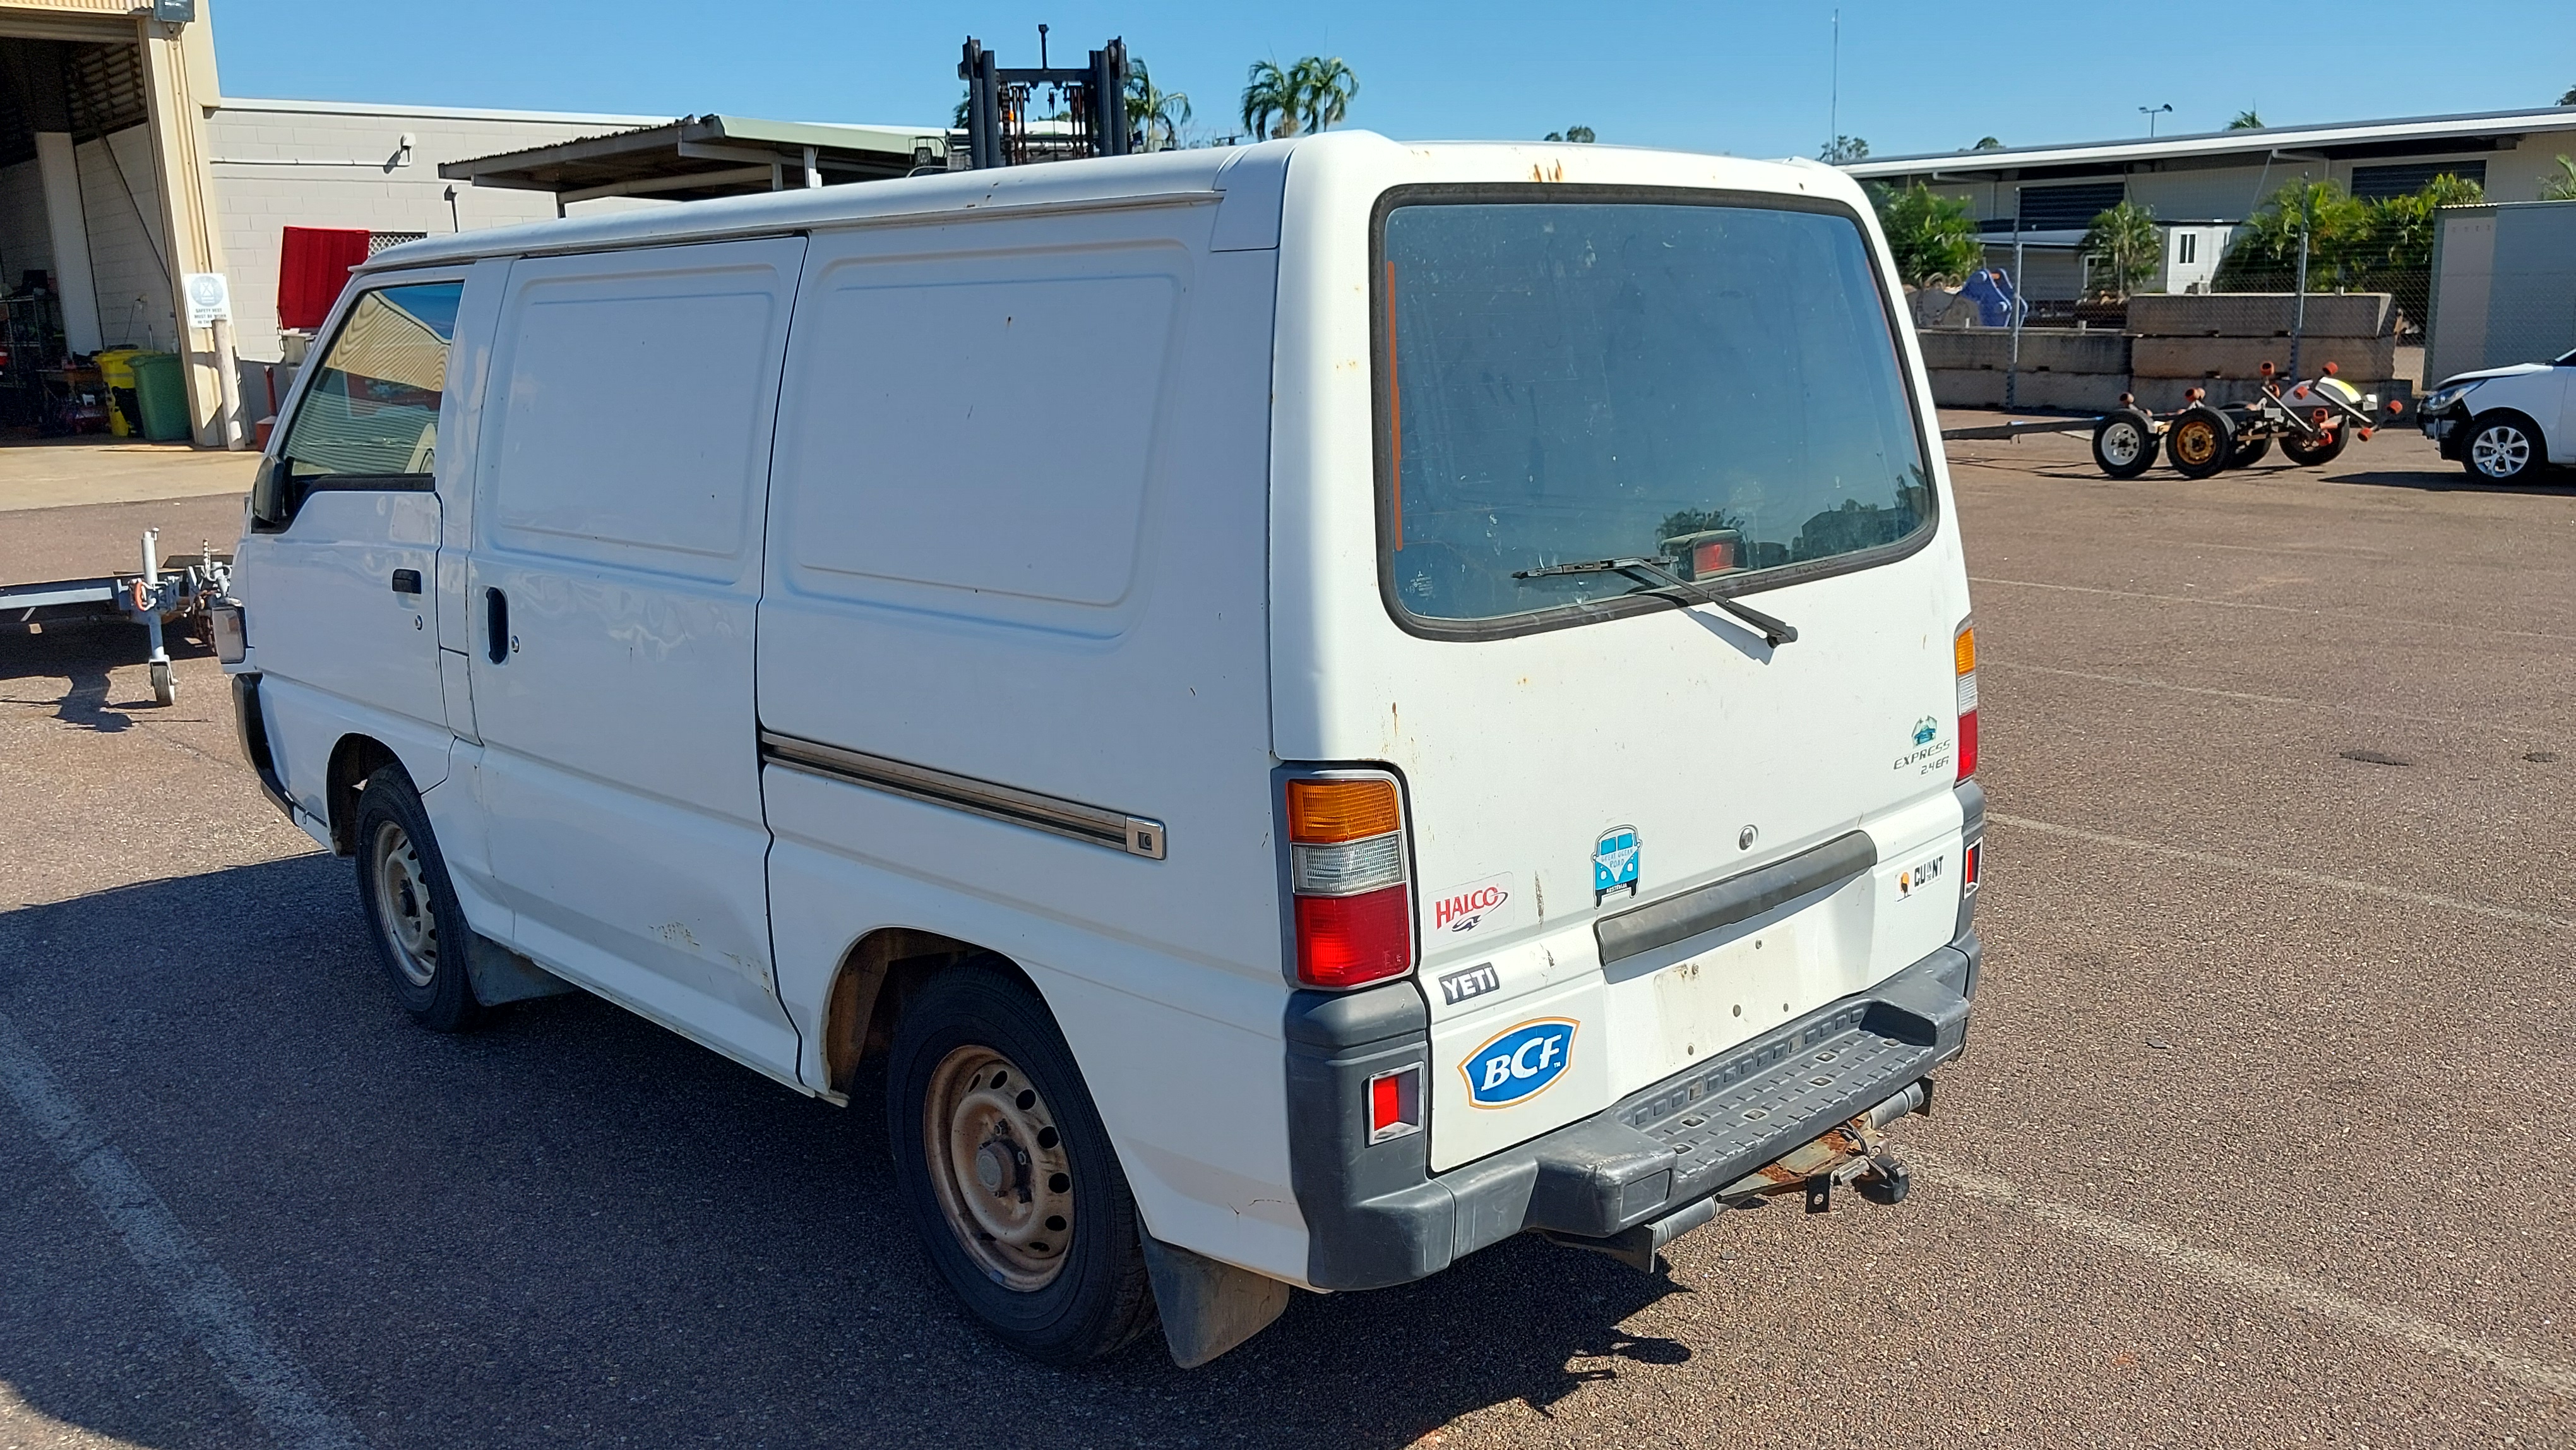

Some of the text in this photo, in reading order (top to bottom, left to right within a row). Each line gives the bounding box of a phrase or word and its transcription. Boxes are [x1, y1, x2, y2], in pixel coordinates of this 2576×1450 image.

[1893, 739, 1950, 770] EXPRESS
[1601, 849, 1633, 862] GREAT OCEAN
[1609, 859, 1625, 868] ROAD
[1435, 887, 1498, 930] HALCO
[1441, 967, 1496, 1000] YETI
[1481, 1033, 1562, 1091] BCF
